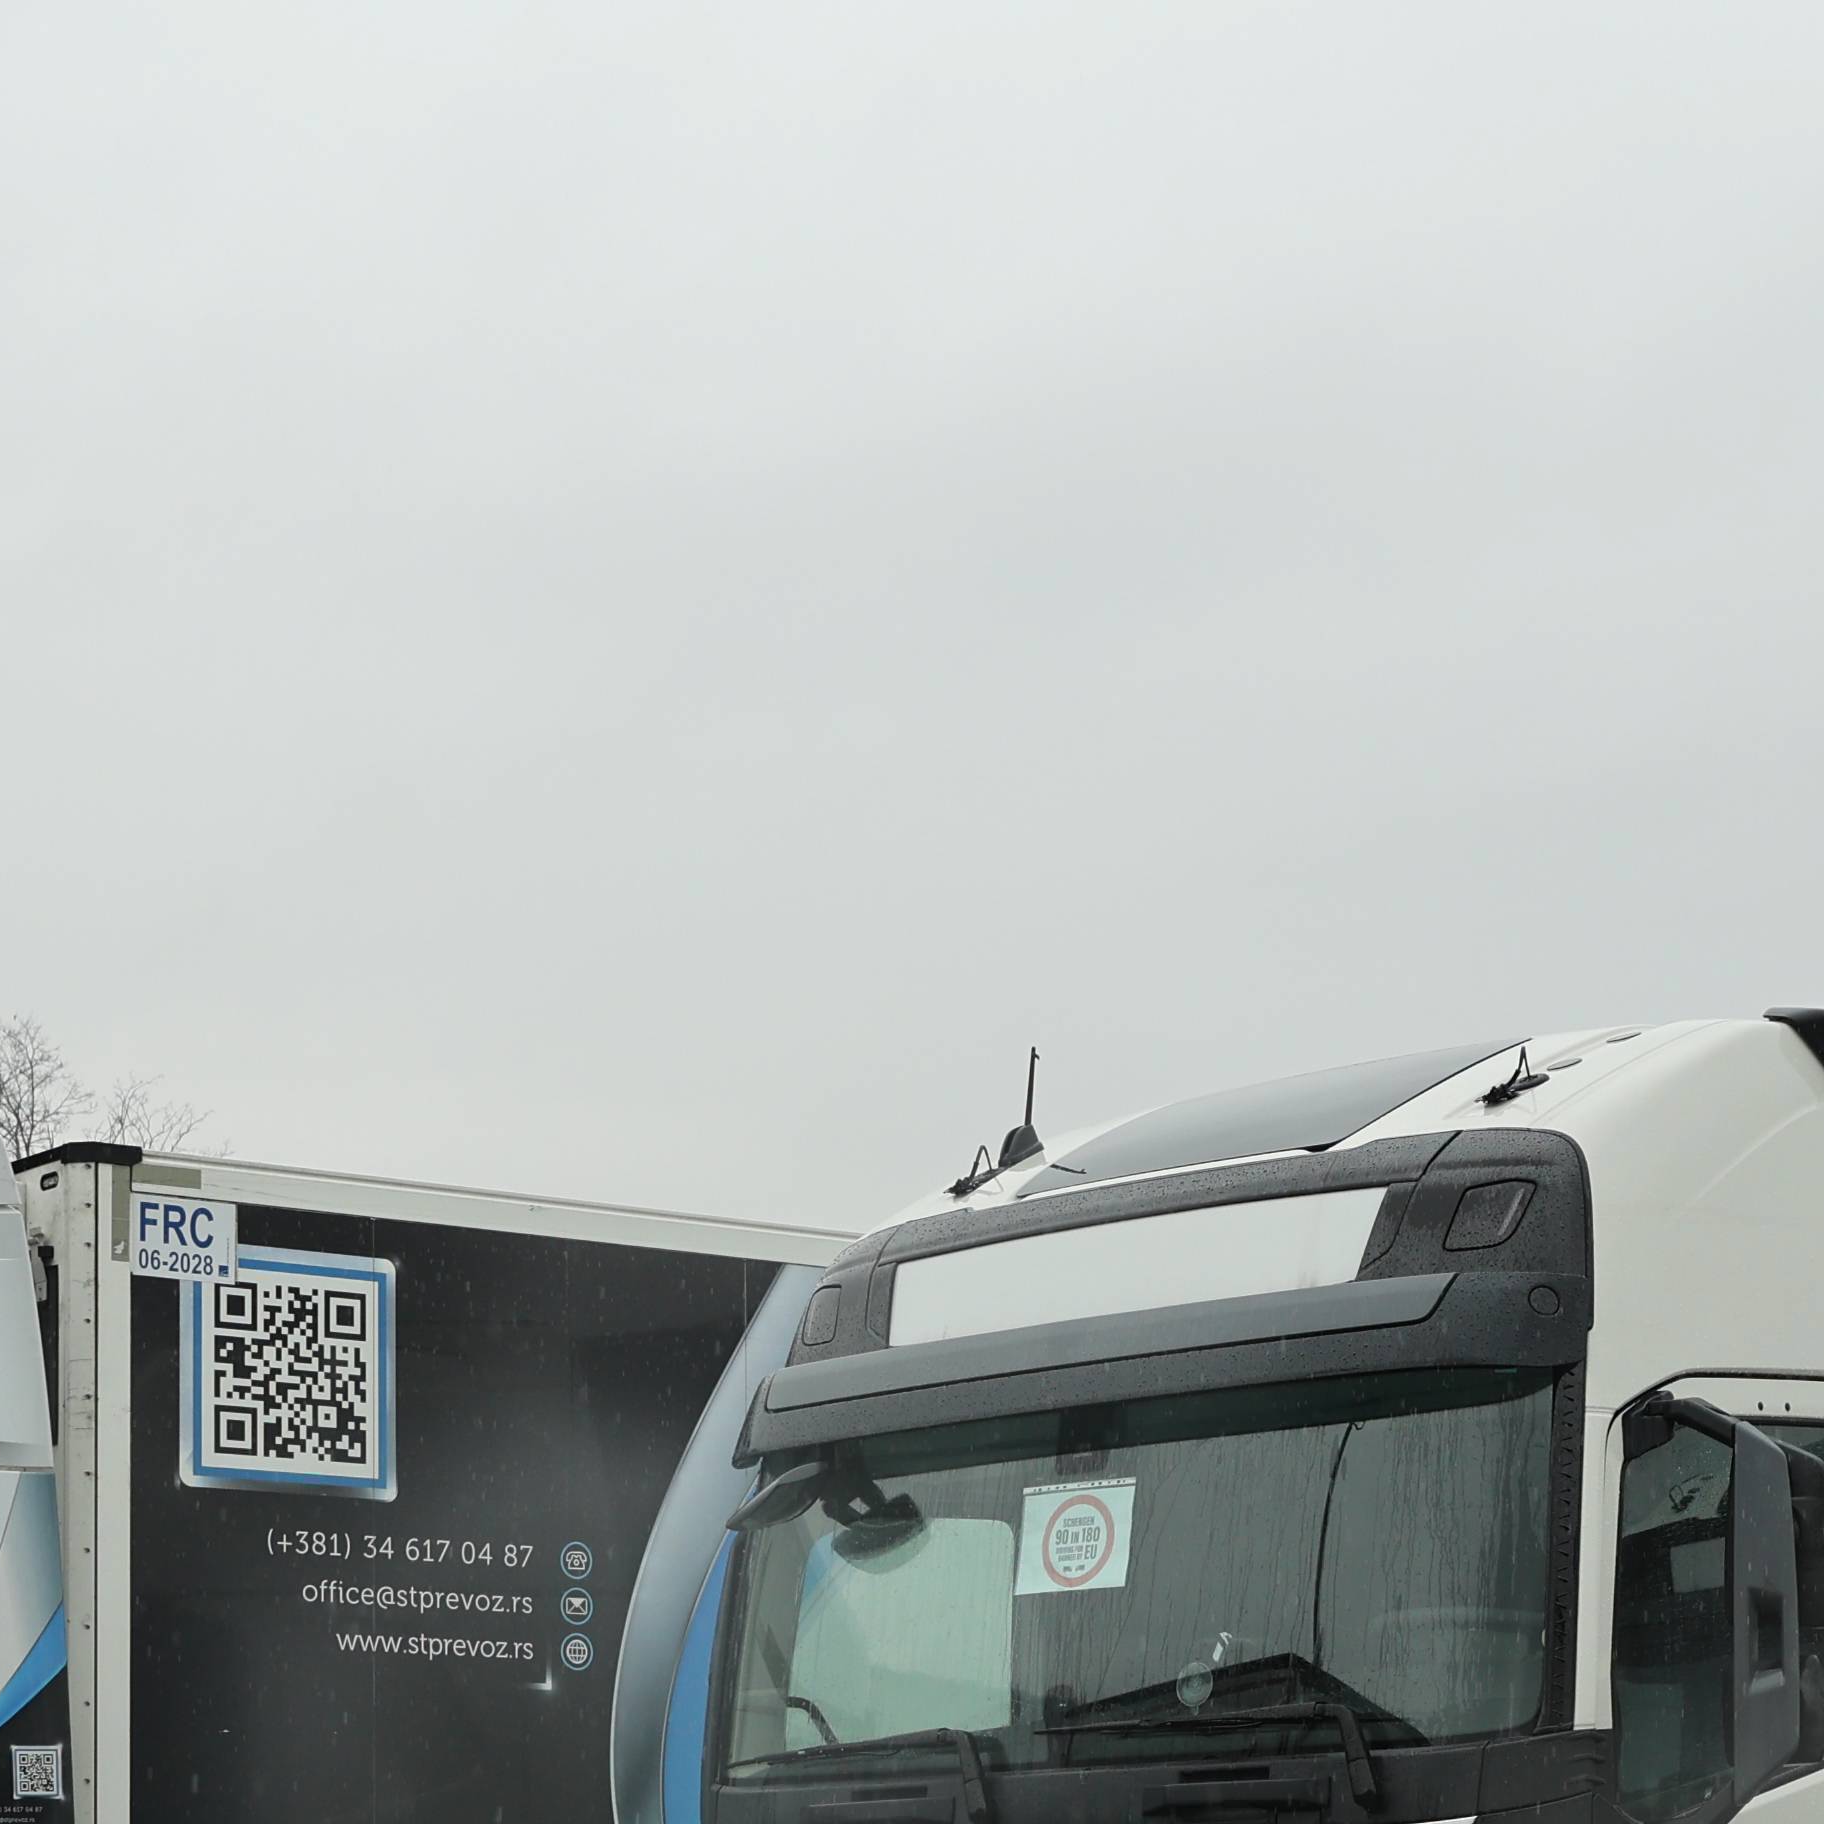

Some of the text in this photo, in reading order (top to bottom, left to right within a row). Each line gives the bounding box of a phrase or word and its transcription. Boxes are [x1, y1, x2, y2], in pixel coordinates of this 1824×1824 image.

[139, 1201, 214, 1249] FRC
[138, 1248, 214, 1276] 06-2028
[267, 1528, 534, 1568] (+381) 34 617 04 87
[1055, 1529, 1069, 1545] 90
[1081, 1527, 1101, 1543] 180
[1084, 1544, 1098, 1560] EU
[302, 1579, 534, 1614] office@stprevoz.rs
[335, 1632, 535, 1661] www.stprevoz.rs
